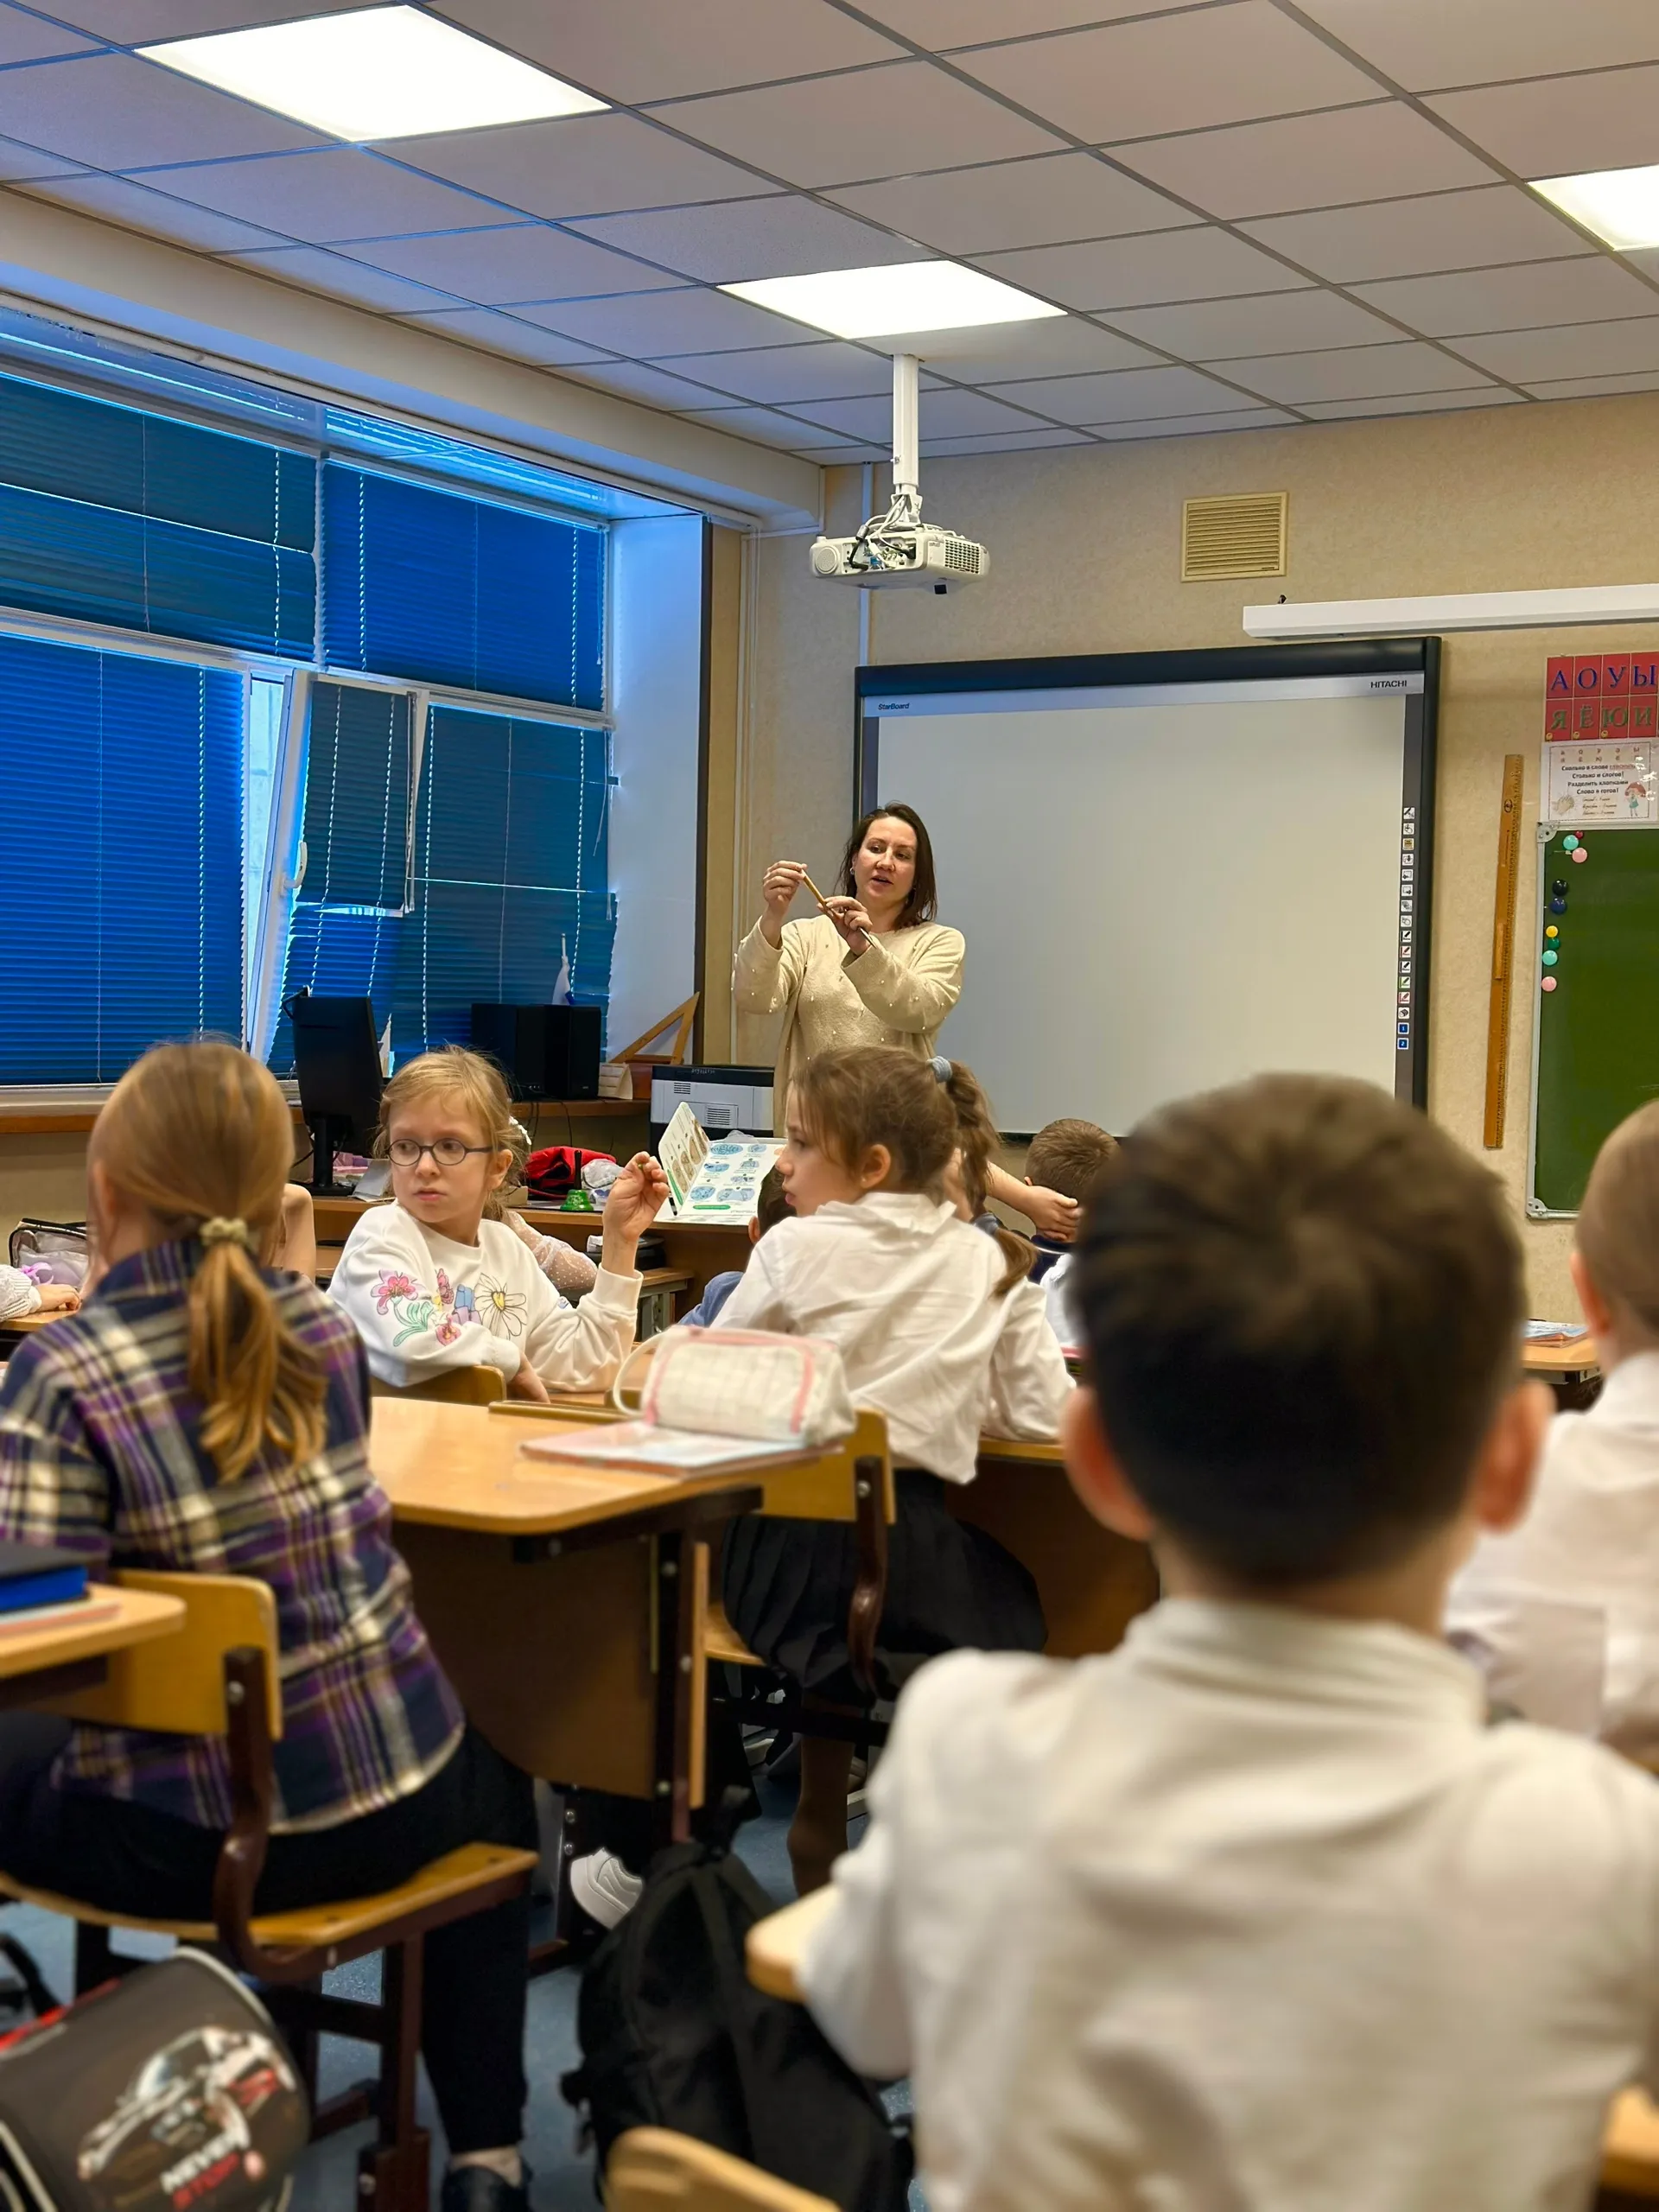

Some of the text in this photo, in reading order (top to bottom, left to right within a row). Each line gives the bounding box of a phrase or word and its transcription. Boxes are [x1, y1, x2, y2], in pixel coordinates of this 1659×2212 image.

[1370, 680, 1408, 689] HITACHI
[1550, 664, 1658, 690] А О У Ы
[1551, 704, 1653, 730] Я Ё Ю И
